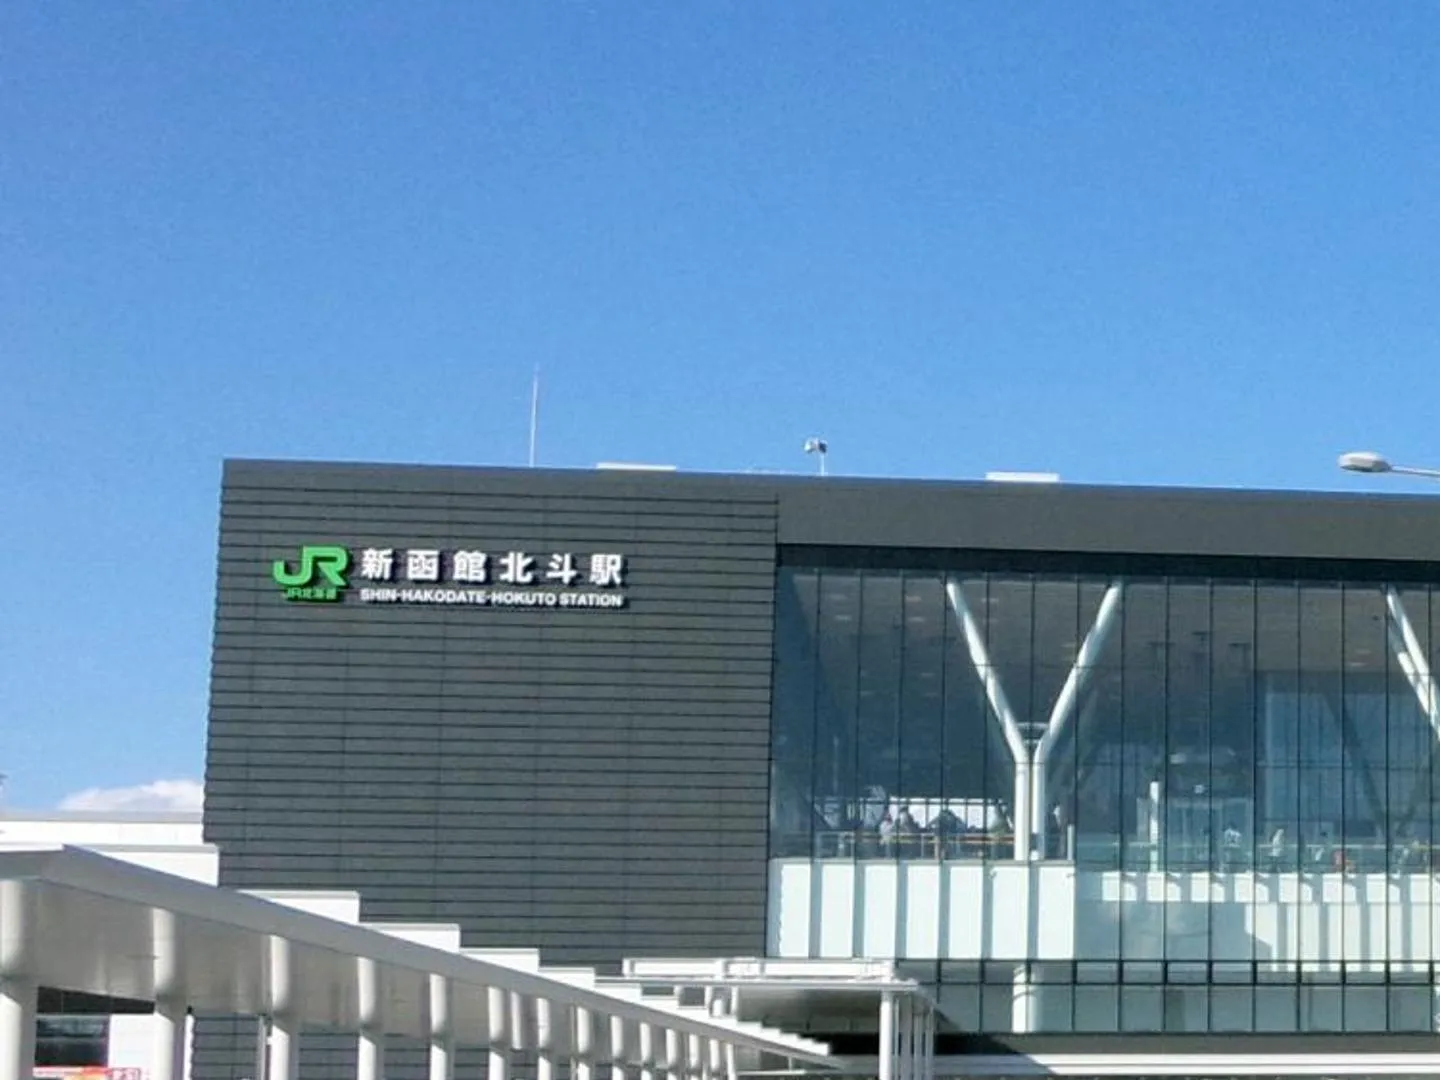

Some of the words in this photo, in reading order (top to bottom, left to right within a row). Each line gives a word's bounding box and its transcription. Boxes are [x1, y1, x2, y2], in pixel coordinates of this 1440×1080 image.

[273, 545, 348, 585] JR
[360, 547, 622, 585] 新函館北斗駅
[360, 588, 556, 605] SHIN-HAKODATE-HOKUTO
[559, 592, 623, 607] STATION
